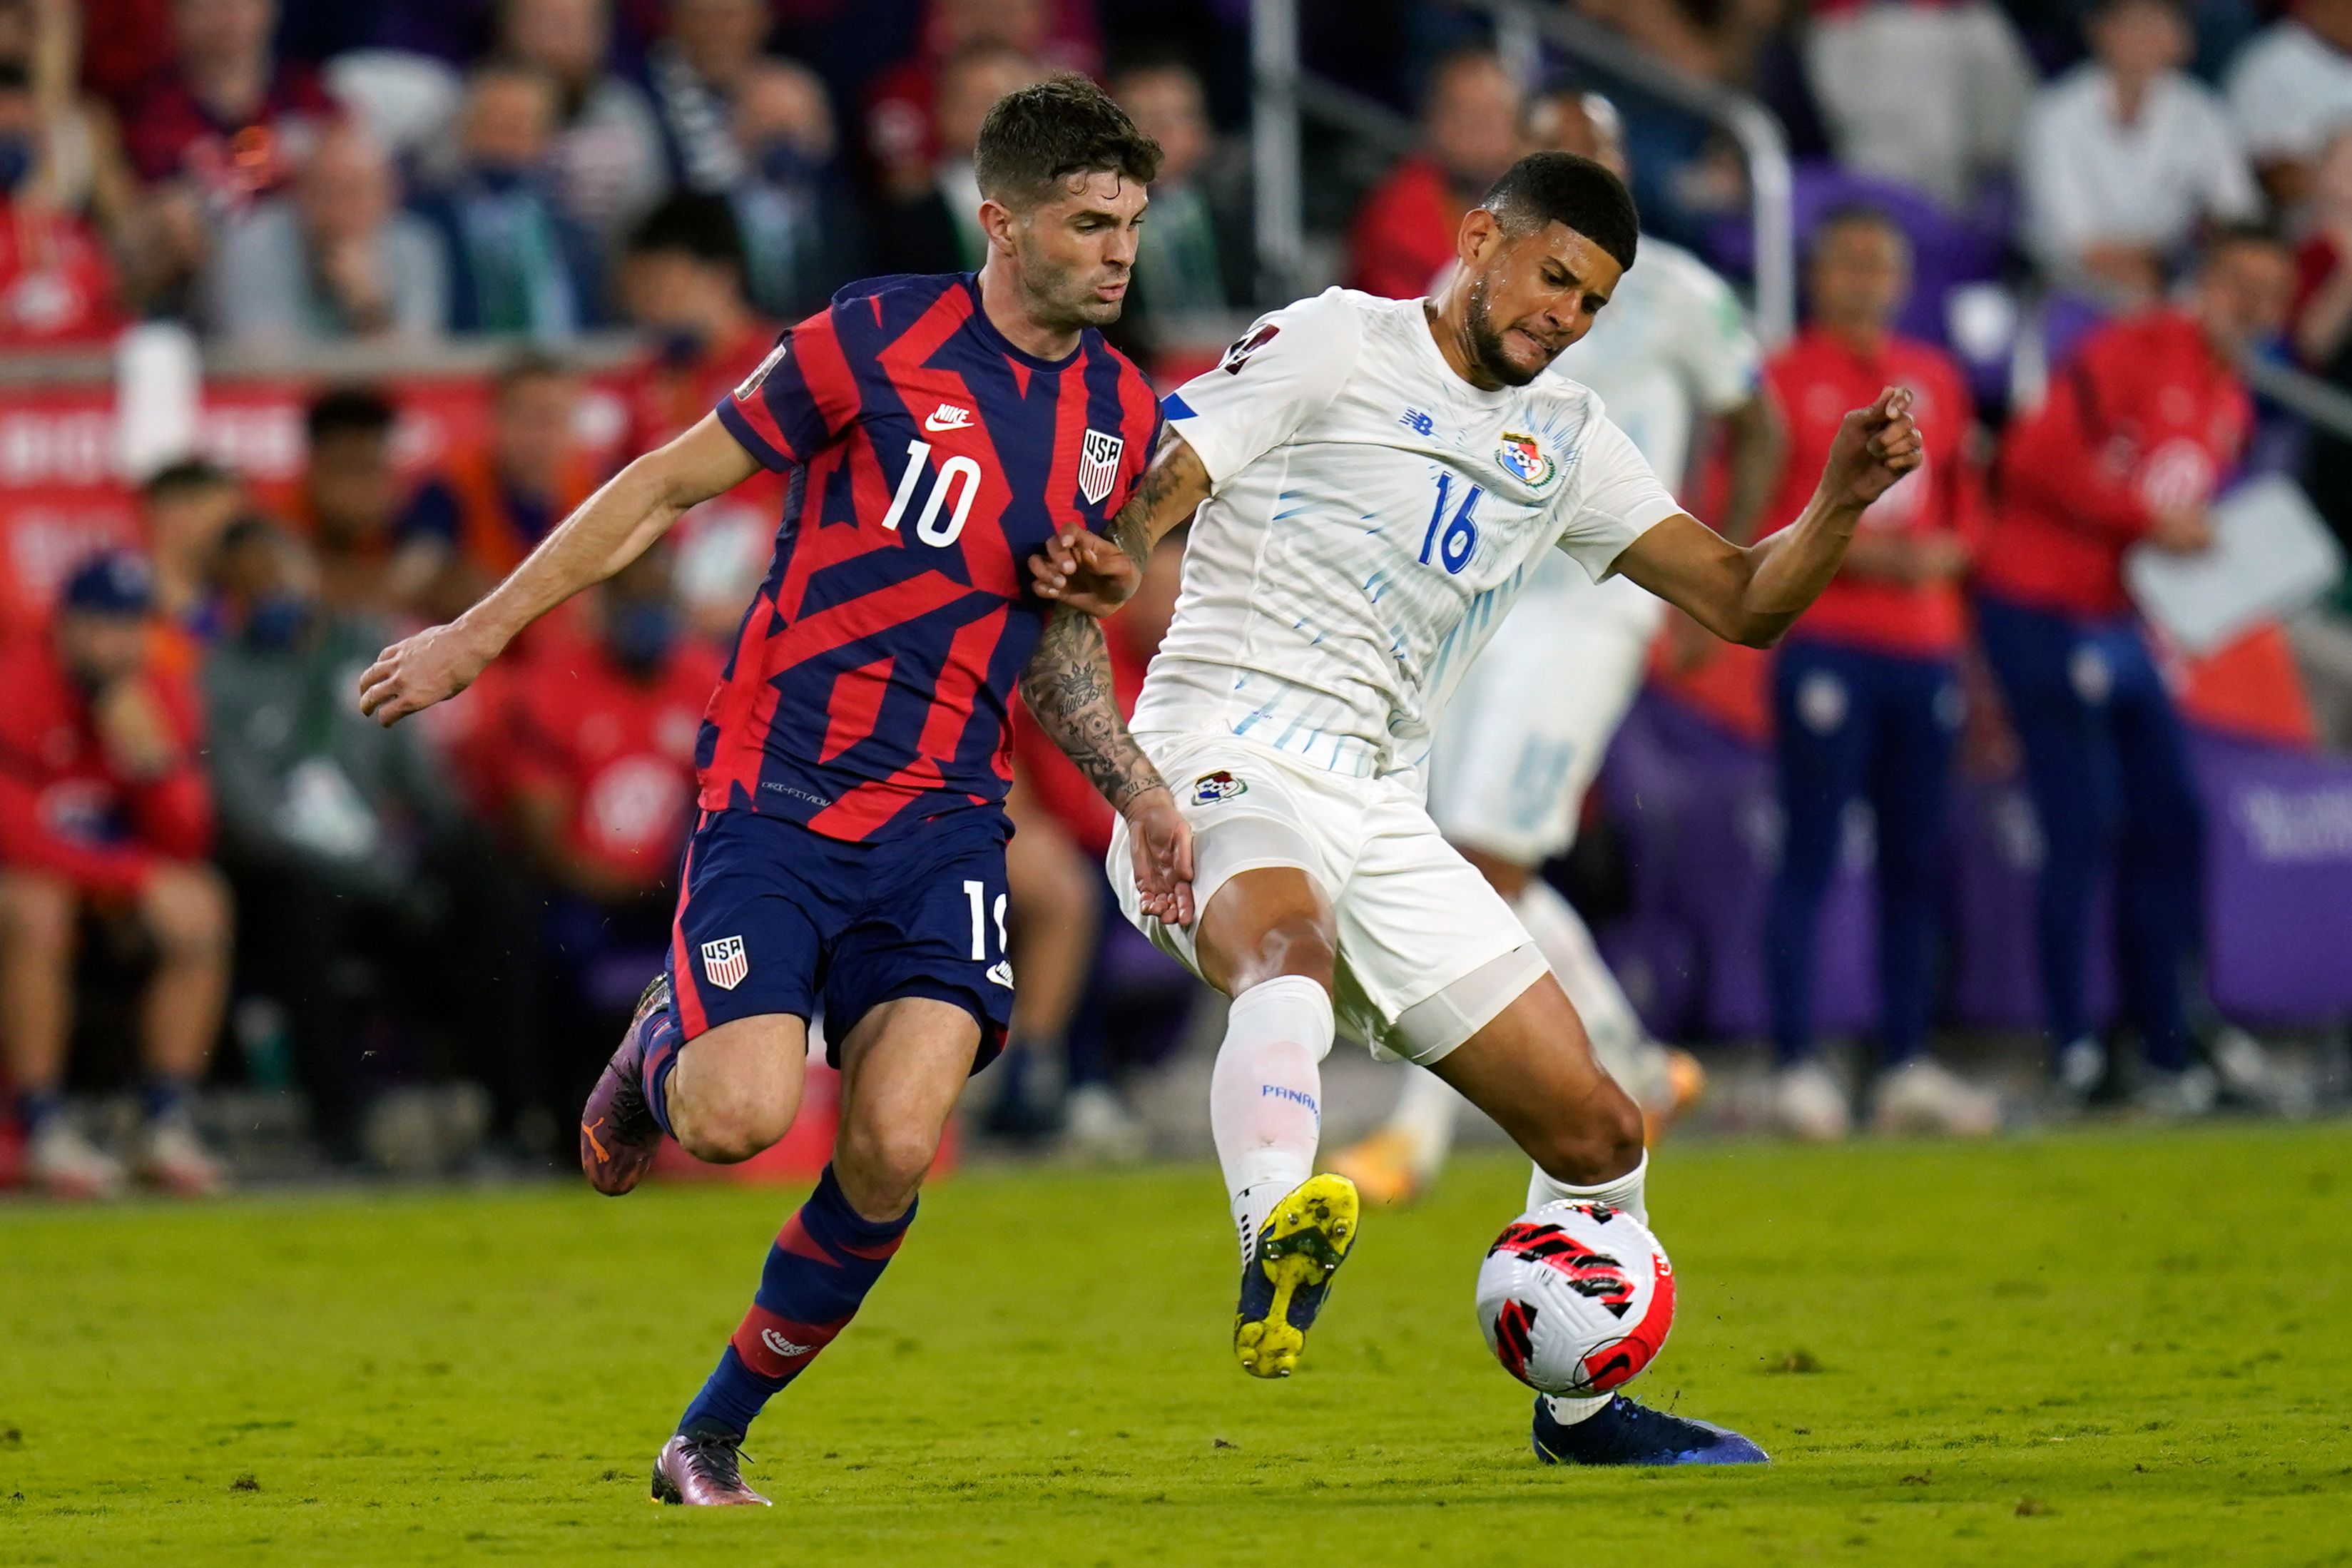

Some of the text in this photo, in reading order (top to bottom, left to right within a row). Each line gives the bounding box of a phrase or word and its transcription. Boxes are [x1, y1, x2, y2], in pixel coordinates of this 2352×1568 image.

[934, 403, 970, 424] NIKE
[1086, 433, 1120, 464] USA
[881, 439, 982, 549] 10
[1418, 470, 1485, 575] 16
[705, 938, 741, 961] USA
[771, 1331, 811, 1355] NIKE
